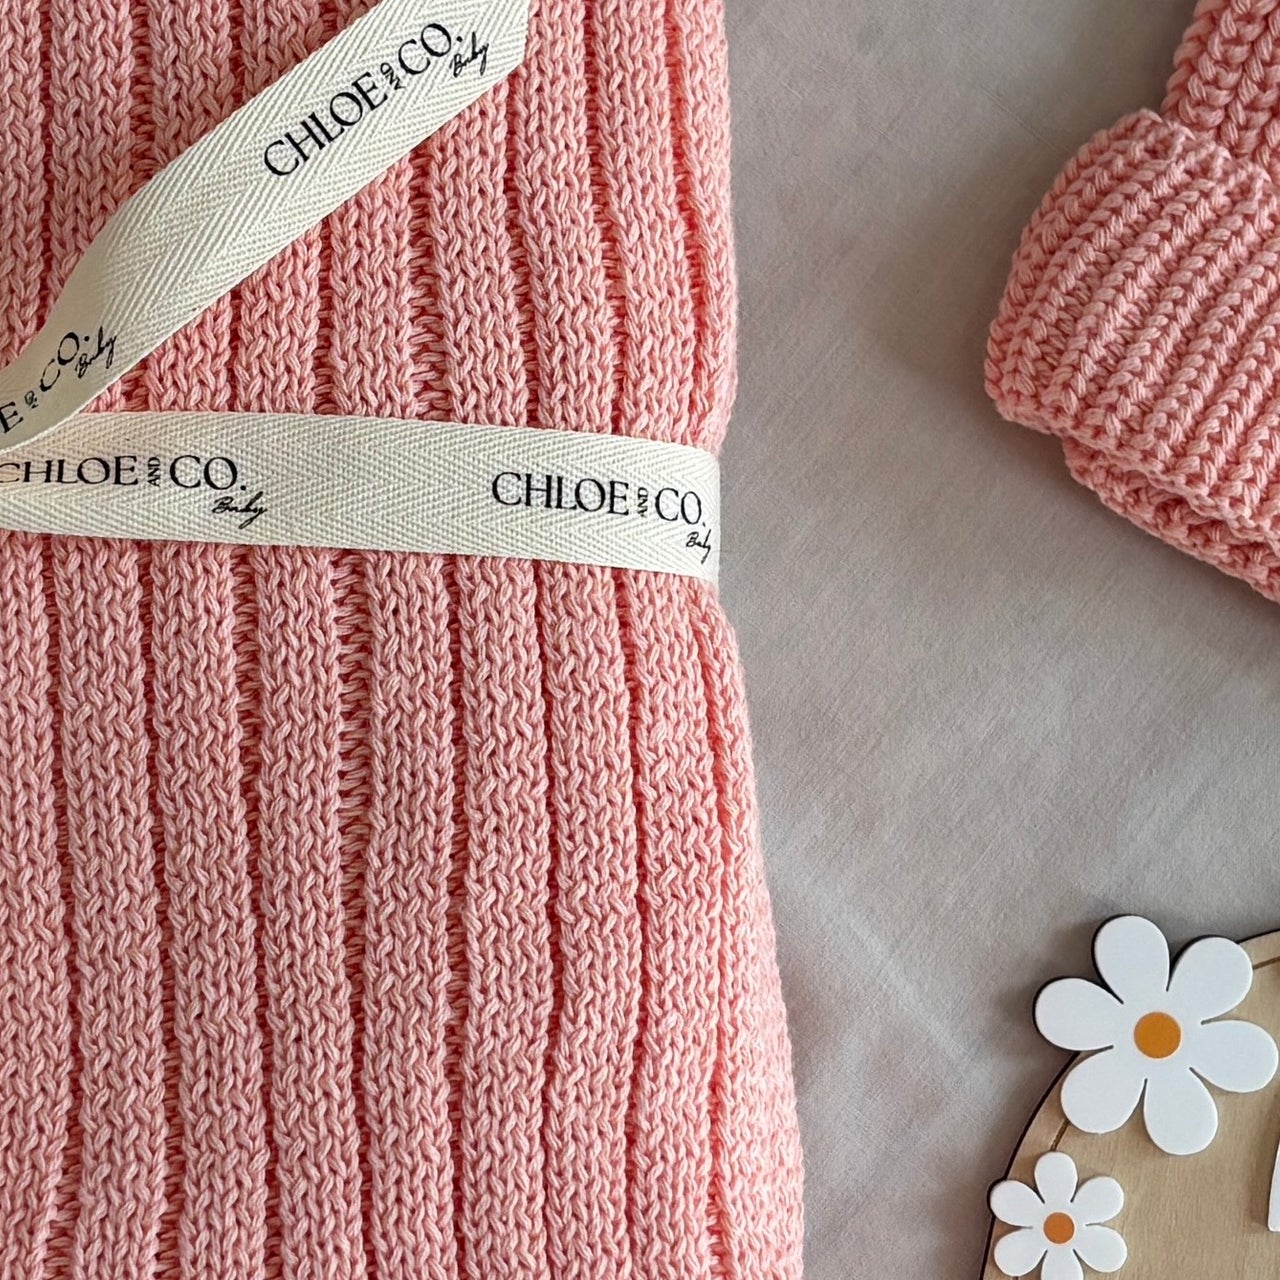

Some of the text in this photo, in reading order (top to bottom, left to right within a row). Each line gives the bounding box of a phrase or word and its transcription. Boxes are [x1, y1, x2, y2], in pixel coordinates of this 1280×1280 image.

[449, 32, 489, 77] Baby
[264, 23, 463, 176] CHLOE AND CO.
[39, 332, 91, 394] CO.
[75, 326, 117, 379] Baby
[147, 457, 162, 487] AND
[169, 455, 247, 492] CO.
[491, 471, 706, 528] CHLOE AND CO.
[212, 491, 268, 529] Baby
